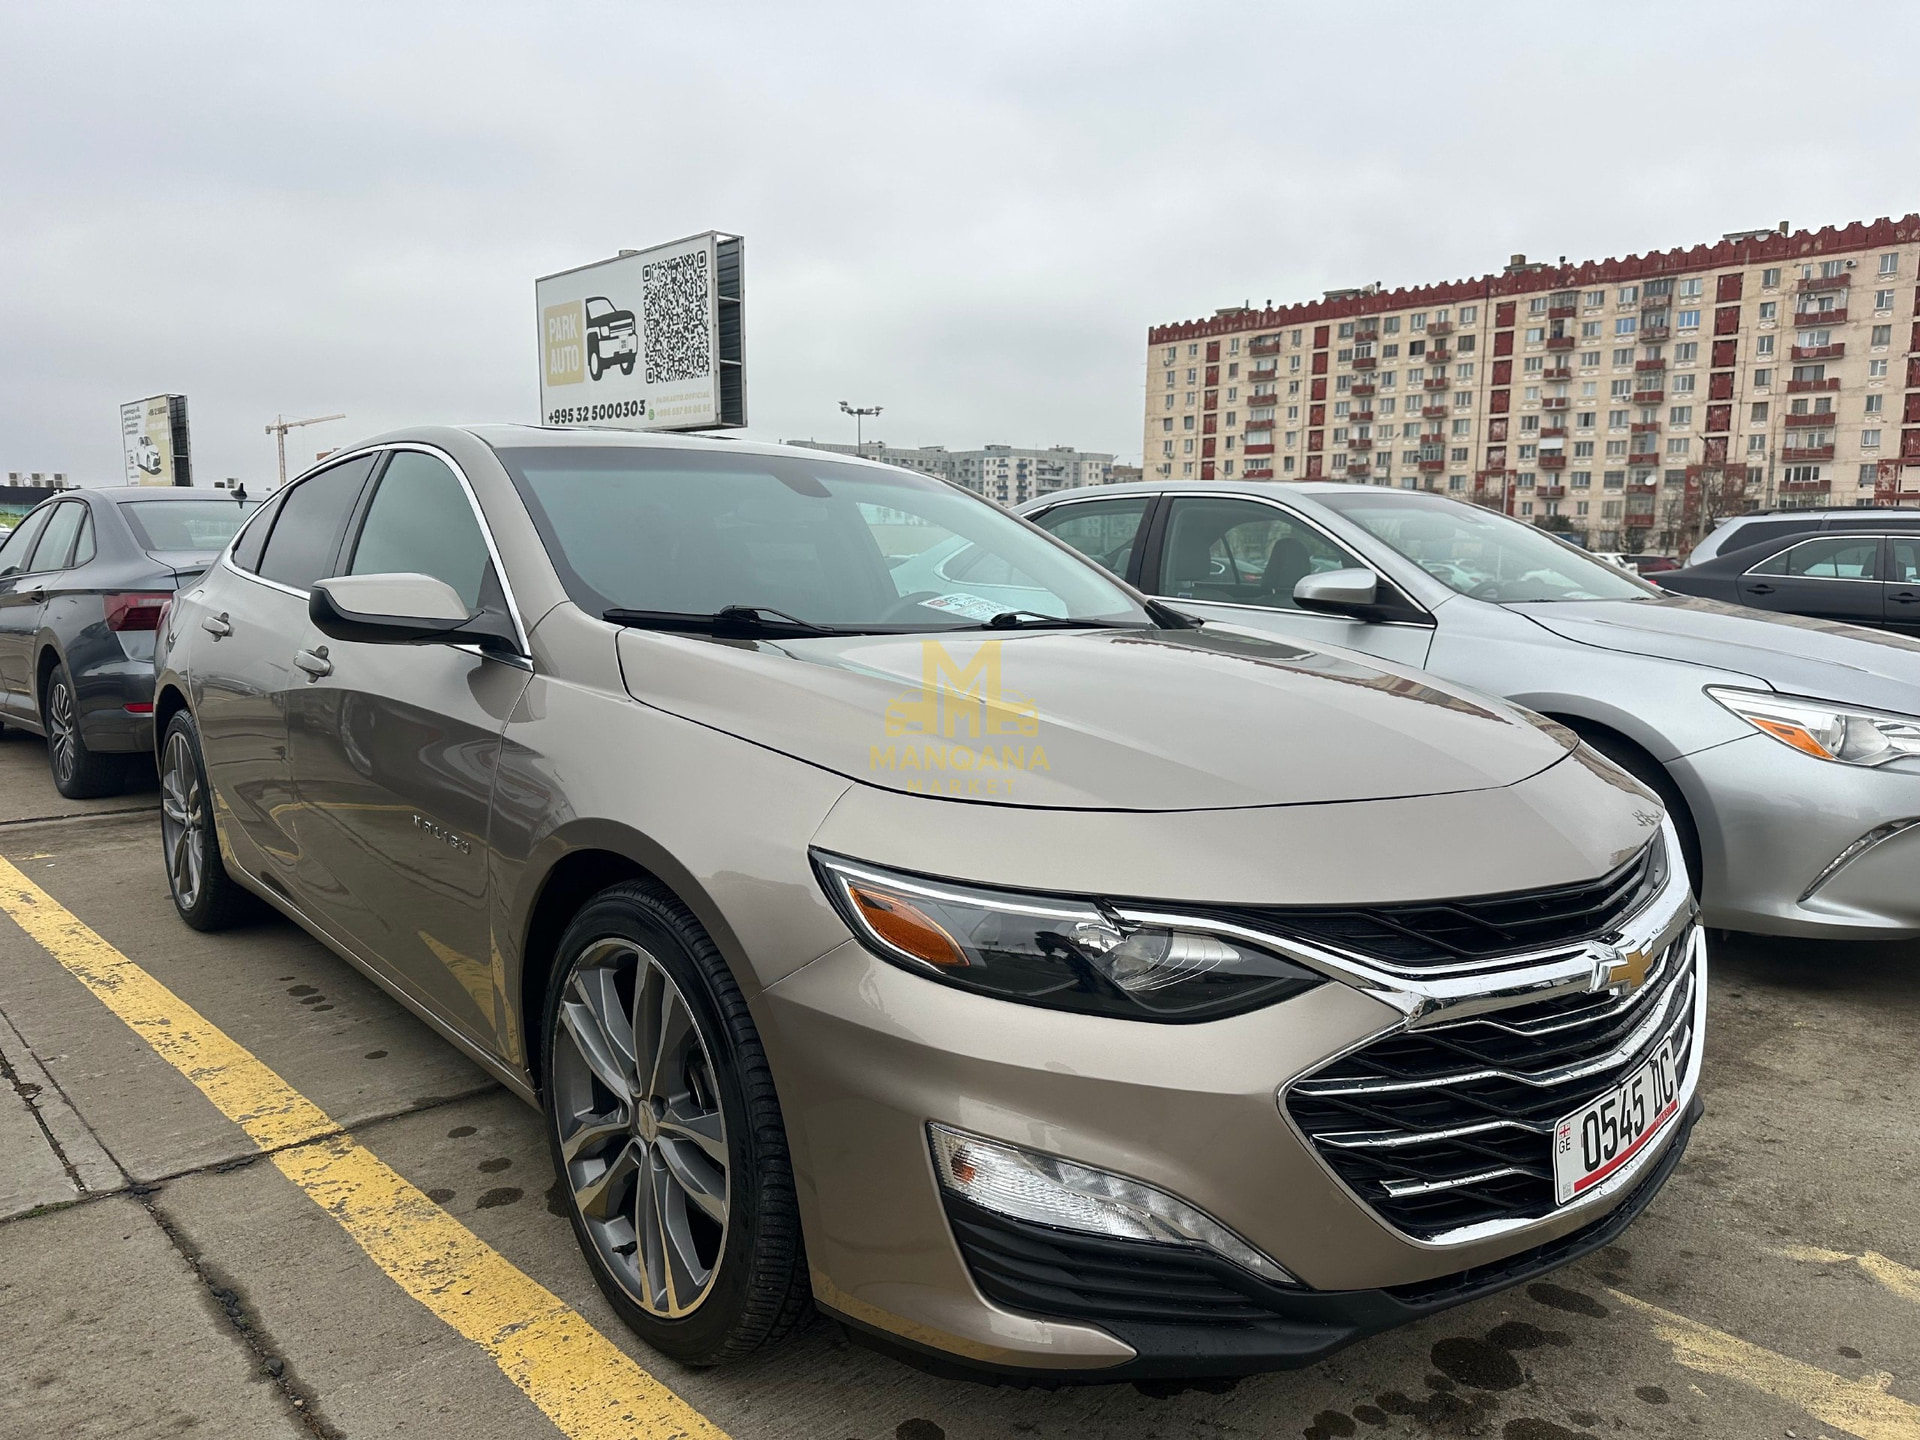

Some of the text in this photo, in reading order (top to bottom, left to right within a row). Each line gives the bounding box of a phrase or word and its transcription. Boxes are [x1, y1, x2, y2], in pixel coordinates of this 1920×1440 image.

[549, 313, 578, 343] PARK
[550, 344, 580, 375] AUTO
[548, 399, 646, 424] +995 32 5000303
[1582, 1047, 1674, 1172] 0545 DC
[1558, 1136, 1571, 1154] GE
